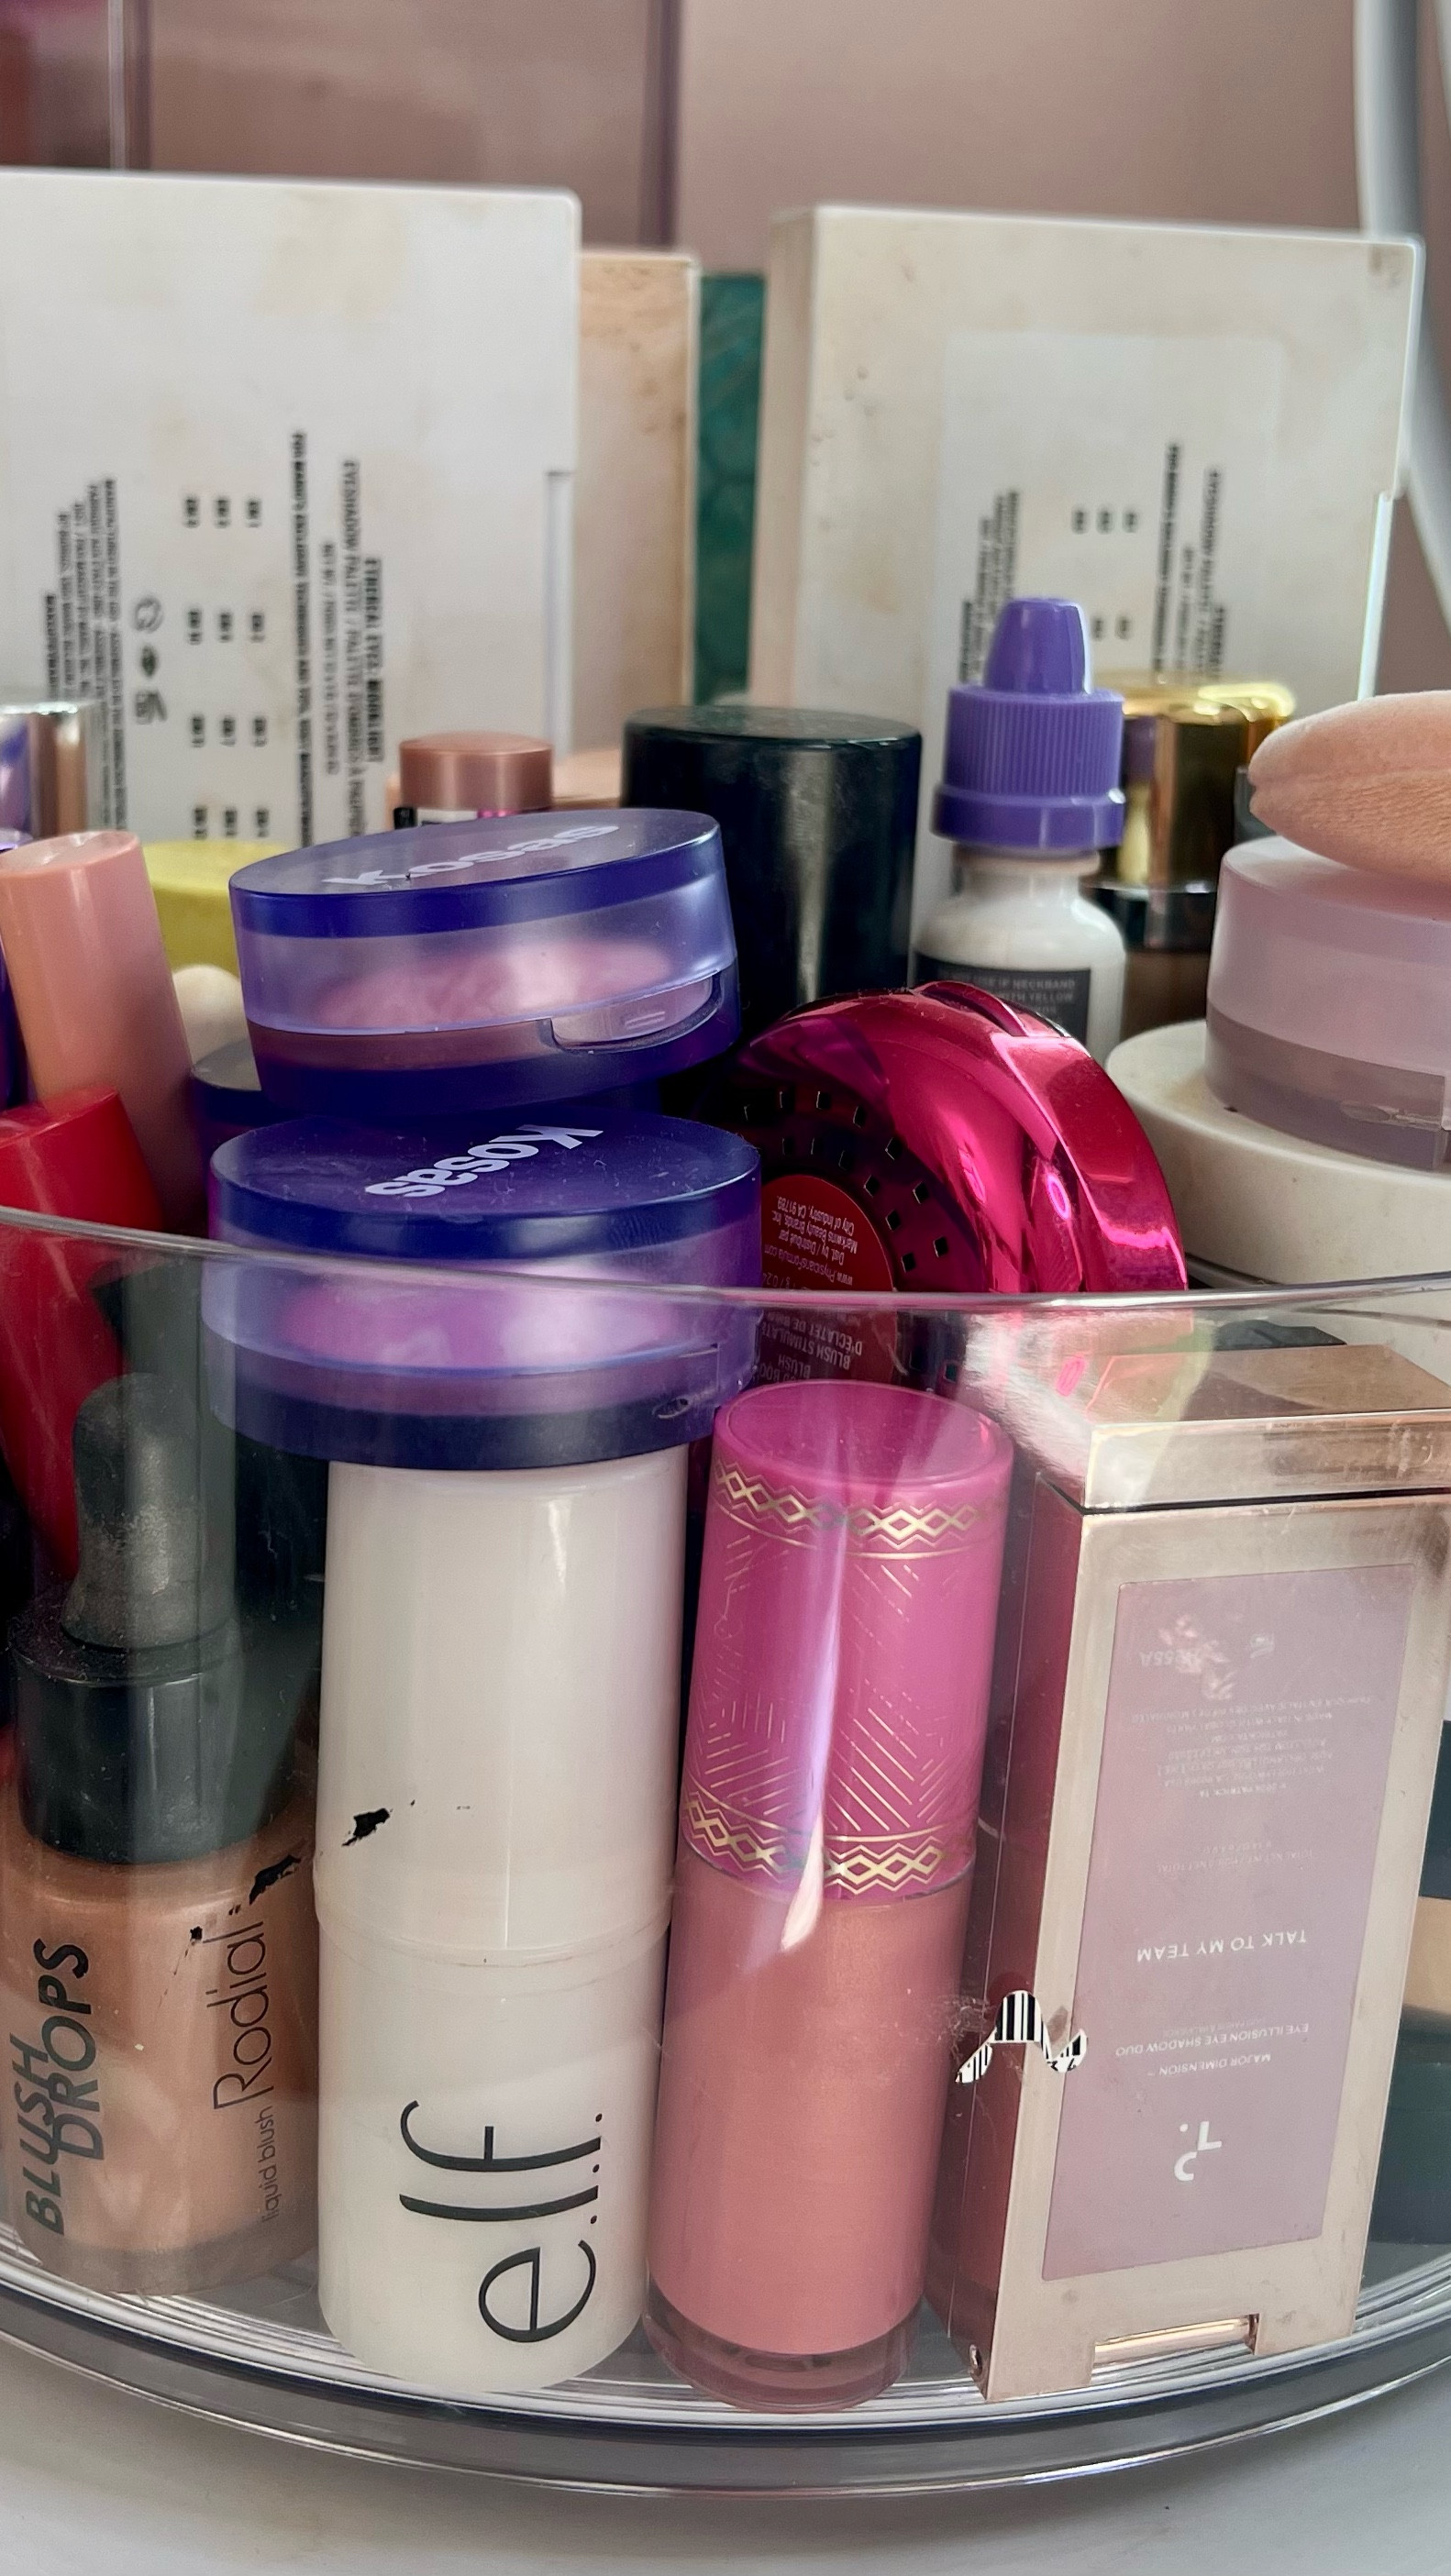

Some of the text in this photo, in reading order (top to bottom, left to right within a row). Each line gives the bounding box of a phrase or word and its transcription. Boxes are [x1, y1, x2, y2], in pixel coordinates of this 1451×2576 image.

[322, 825, 619, 886] Kosas
[364, 1124, 604, 1198] Kosas
[798, 1204, 806, 1219] CA
[834, 1218, 841, 1230] of
[842, 1218, 854, 1236] City
[821, 1244, 829, 1259] by
[778, 1354, 811, 1379] BLUSH
[816, 1343, 850, 1371] BLUSH
[1136, 1929, 1307, 1962] TALK TO MY TEAM
[202, 1921, 274, 2108] Rodial
[1204, 2033, 1227, 2044] EYE
[1230, 2025, 1284, 2041] ILLUSION
[1285, 2022, 1309, 2035] EYE
[32, 1939, 105, 2161] DROPS
[1114, 2043, 1143, 2057] DUO
[1146, 2036, 1202, 2052] SHADOW
[1230, 2053, 1271, 2067] MAJOR
[9, 2034, 65, 2235] BLUSH
[256, 2106, 277, 2160] blush
[258, 2165, 282, 2222] liquid
